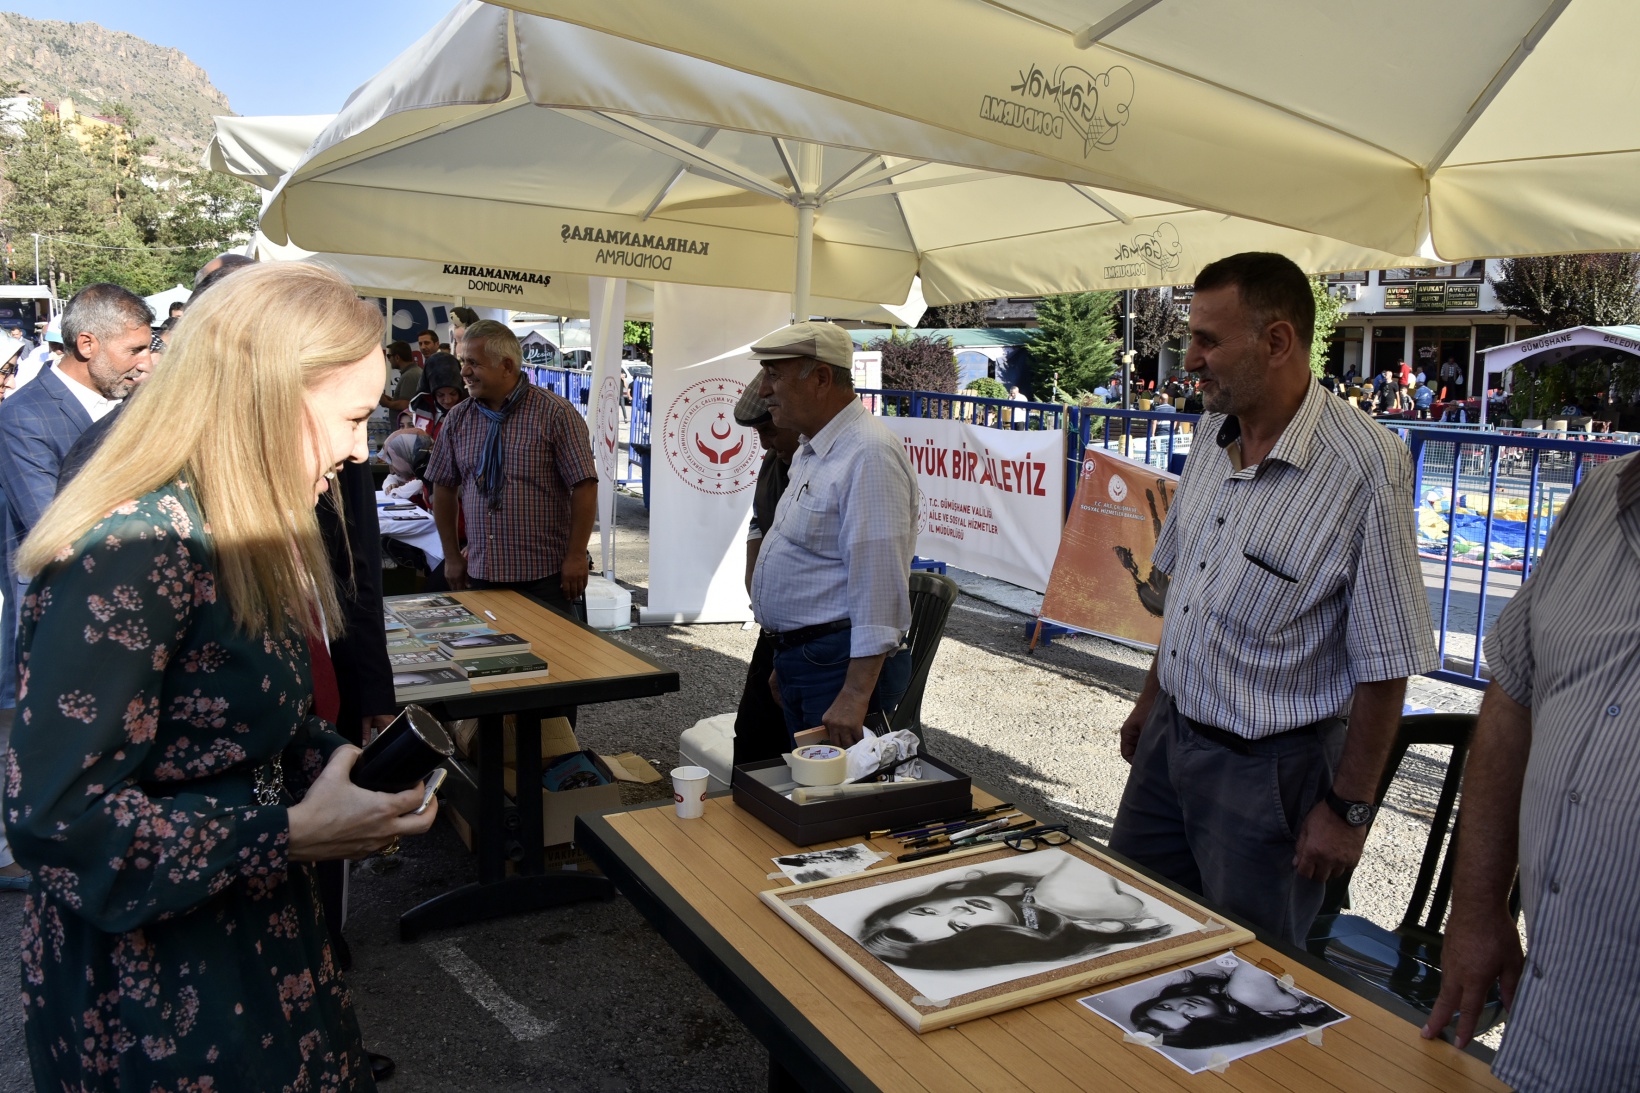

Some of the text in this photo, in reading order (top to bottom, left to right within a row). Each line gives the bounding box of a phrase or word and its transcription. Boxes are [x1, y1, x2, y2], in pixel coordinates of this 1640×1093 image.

[442, 264, 552, 287] KAHRAMANMARAŞ
[468, 279, 524, 295] DONDURMA
[1521, 334, 1572, 353] GÜMÜŞHANE
[1561, 405, 1577, 415] 29
[904, 437, 1046, 497] ÜYÜK BİR AİLEYİZ
[929, 498, 940, 508] T.C.
[940, 498, 971, 515] GÜMÜŞHANE
[928, 521, 965, 541] İL MÜDÜRLÜĞÜ
[929, 509, 998, 535] AİLE VE SOSYAL HİZMETLER
